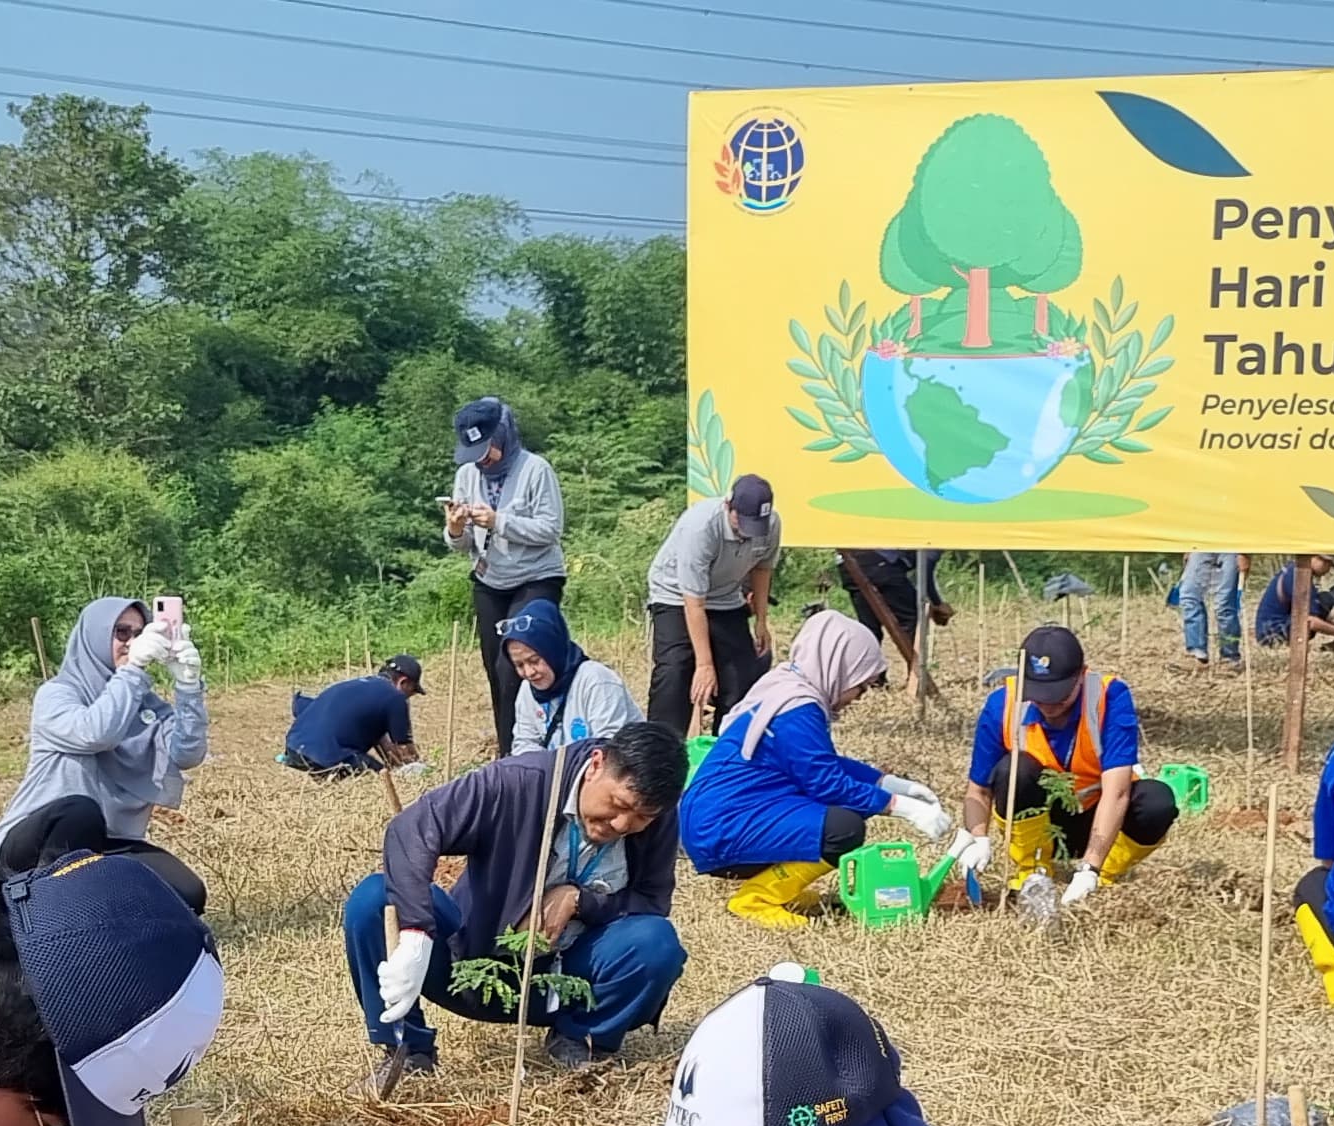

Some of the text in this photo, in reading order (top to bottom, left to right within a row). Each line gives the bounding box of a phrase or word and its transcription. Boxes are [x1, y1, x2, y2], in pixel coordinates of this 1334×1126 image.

[1210, 260, 1326, 309] Hari
[1199, 426, 1303, 450] Inovasi
[814, 1097, 846, 1116] SAFETY
[825, 1109, 849, 1126] FIRST
